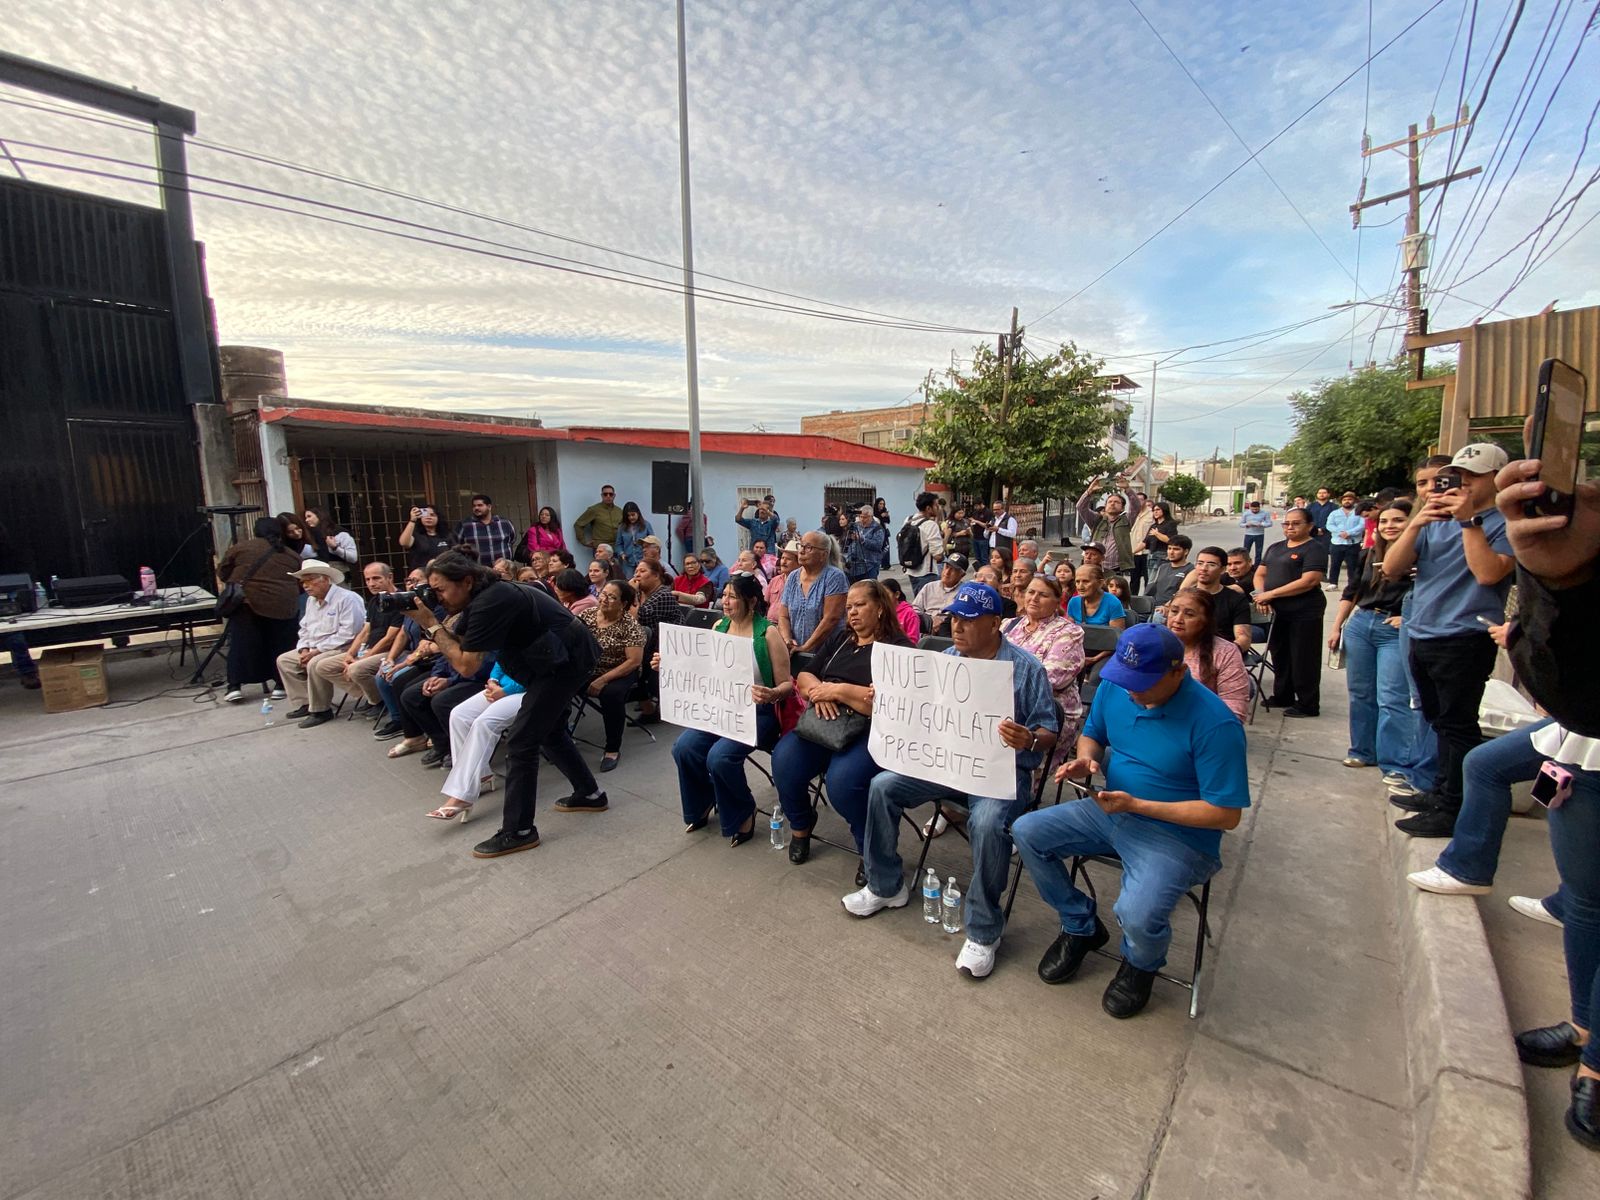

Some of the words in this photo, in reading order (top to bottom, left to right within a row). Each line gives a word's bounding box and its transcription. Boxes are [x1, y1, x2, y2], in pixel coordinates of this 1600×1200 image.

[978, 589, 994, 610] LA
[666, 630, 735, 669] NUEVO
[882, 651, 971, 704] NUEVO
[673, 699, 745, 733] PRESENTE
[883, 735, 987, 779] PRESENTE
